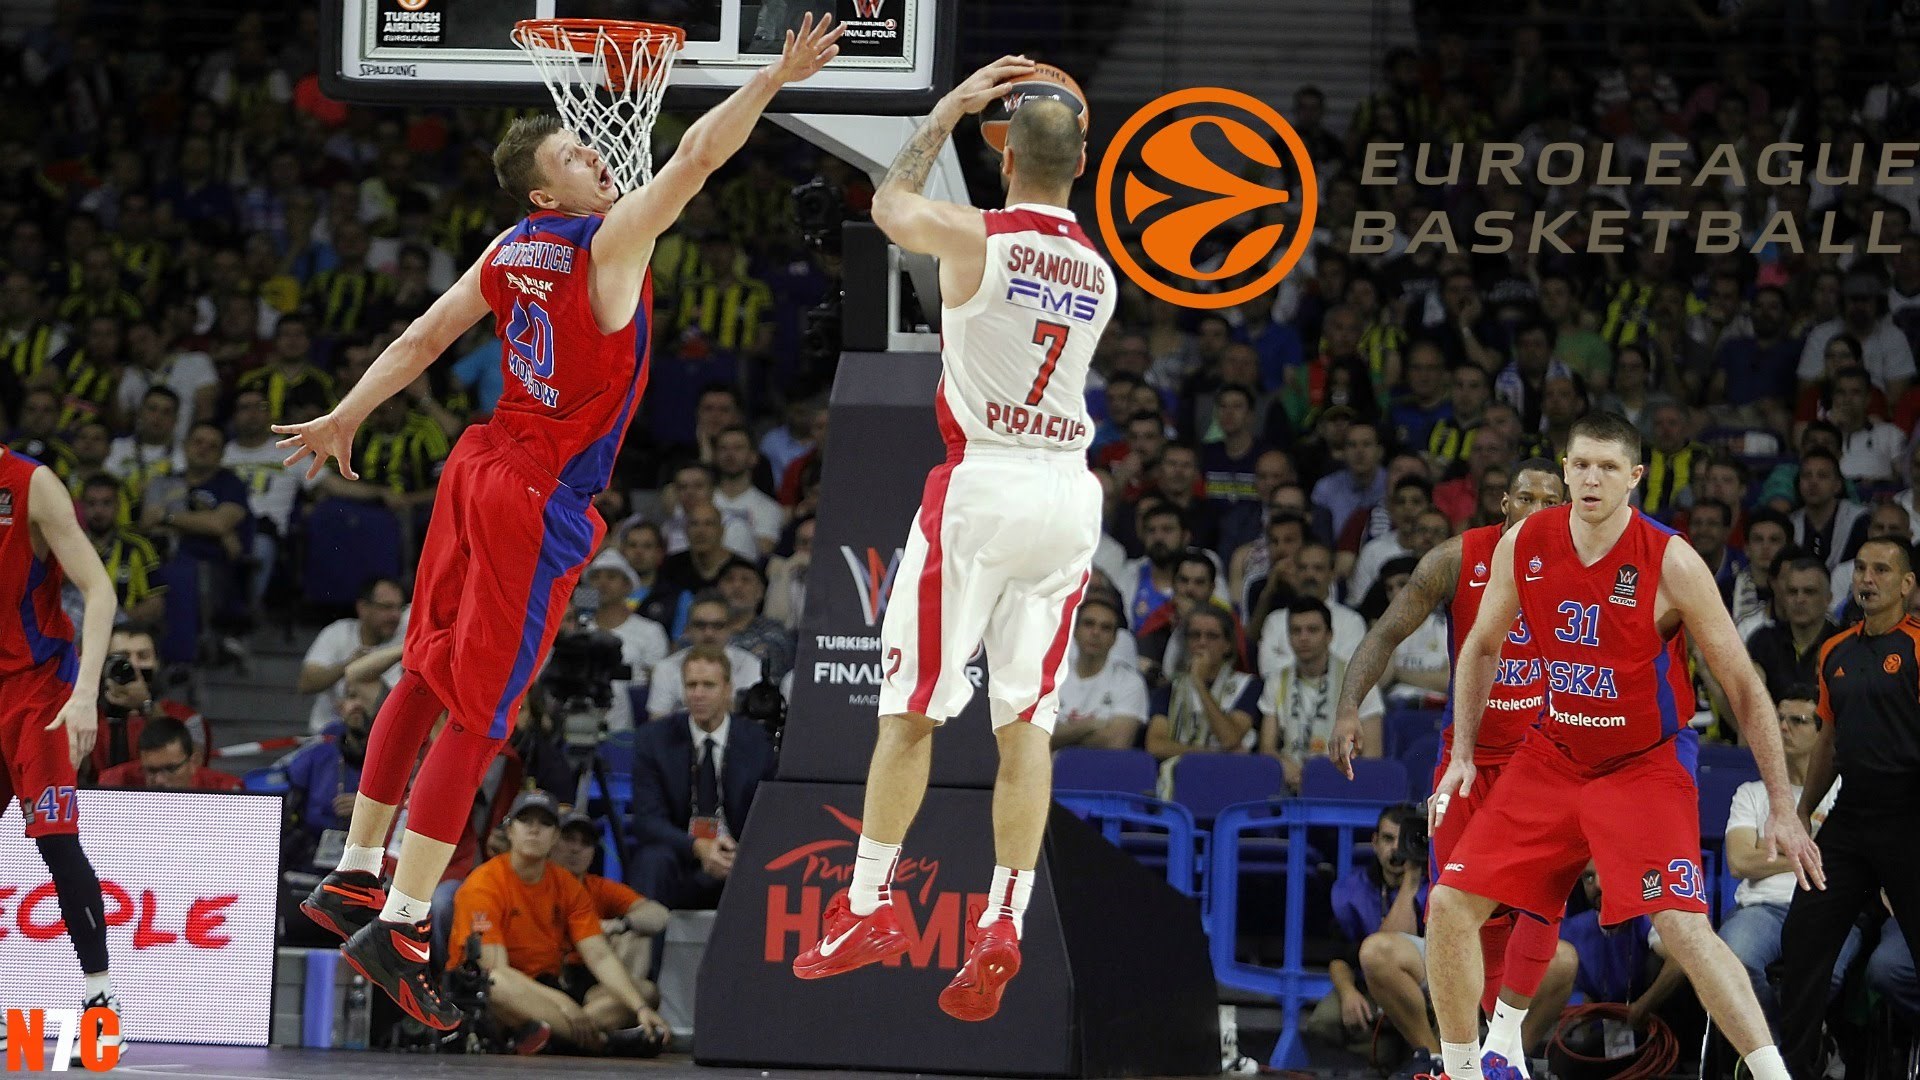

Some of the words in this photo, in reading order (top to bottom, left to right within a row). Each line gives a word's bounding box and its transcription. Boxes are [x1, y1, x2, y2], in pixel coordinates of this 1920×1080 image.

[383, 22, 440, 33] AIRLINES
[384, 12, 440, 22] TURKISH
[872, 30, 896, 38] FOUR
[359, 63, 417, 77] SPALDING
[1007, 243, 1105, 295] SPANOULIS
[1024, 318, 1071, 407] 7
[509, 349, 559, 408] MOSCOW
[1555, 600, 1600, 647] 31
[816, 635, 882, 650] TURKISH
[814, 661, 884, 685] FINAL
[1549, 660, 1618, 699] SKA
[1553, 711, 1626, 728] ostelecom
[35, 785, 76, 823] 47
[1668, 858, 1707, 904] 31
